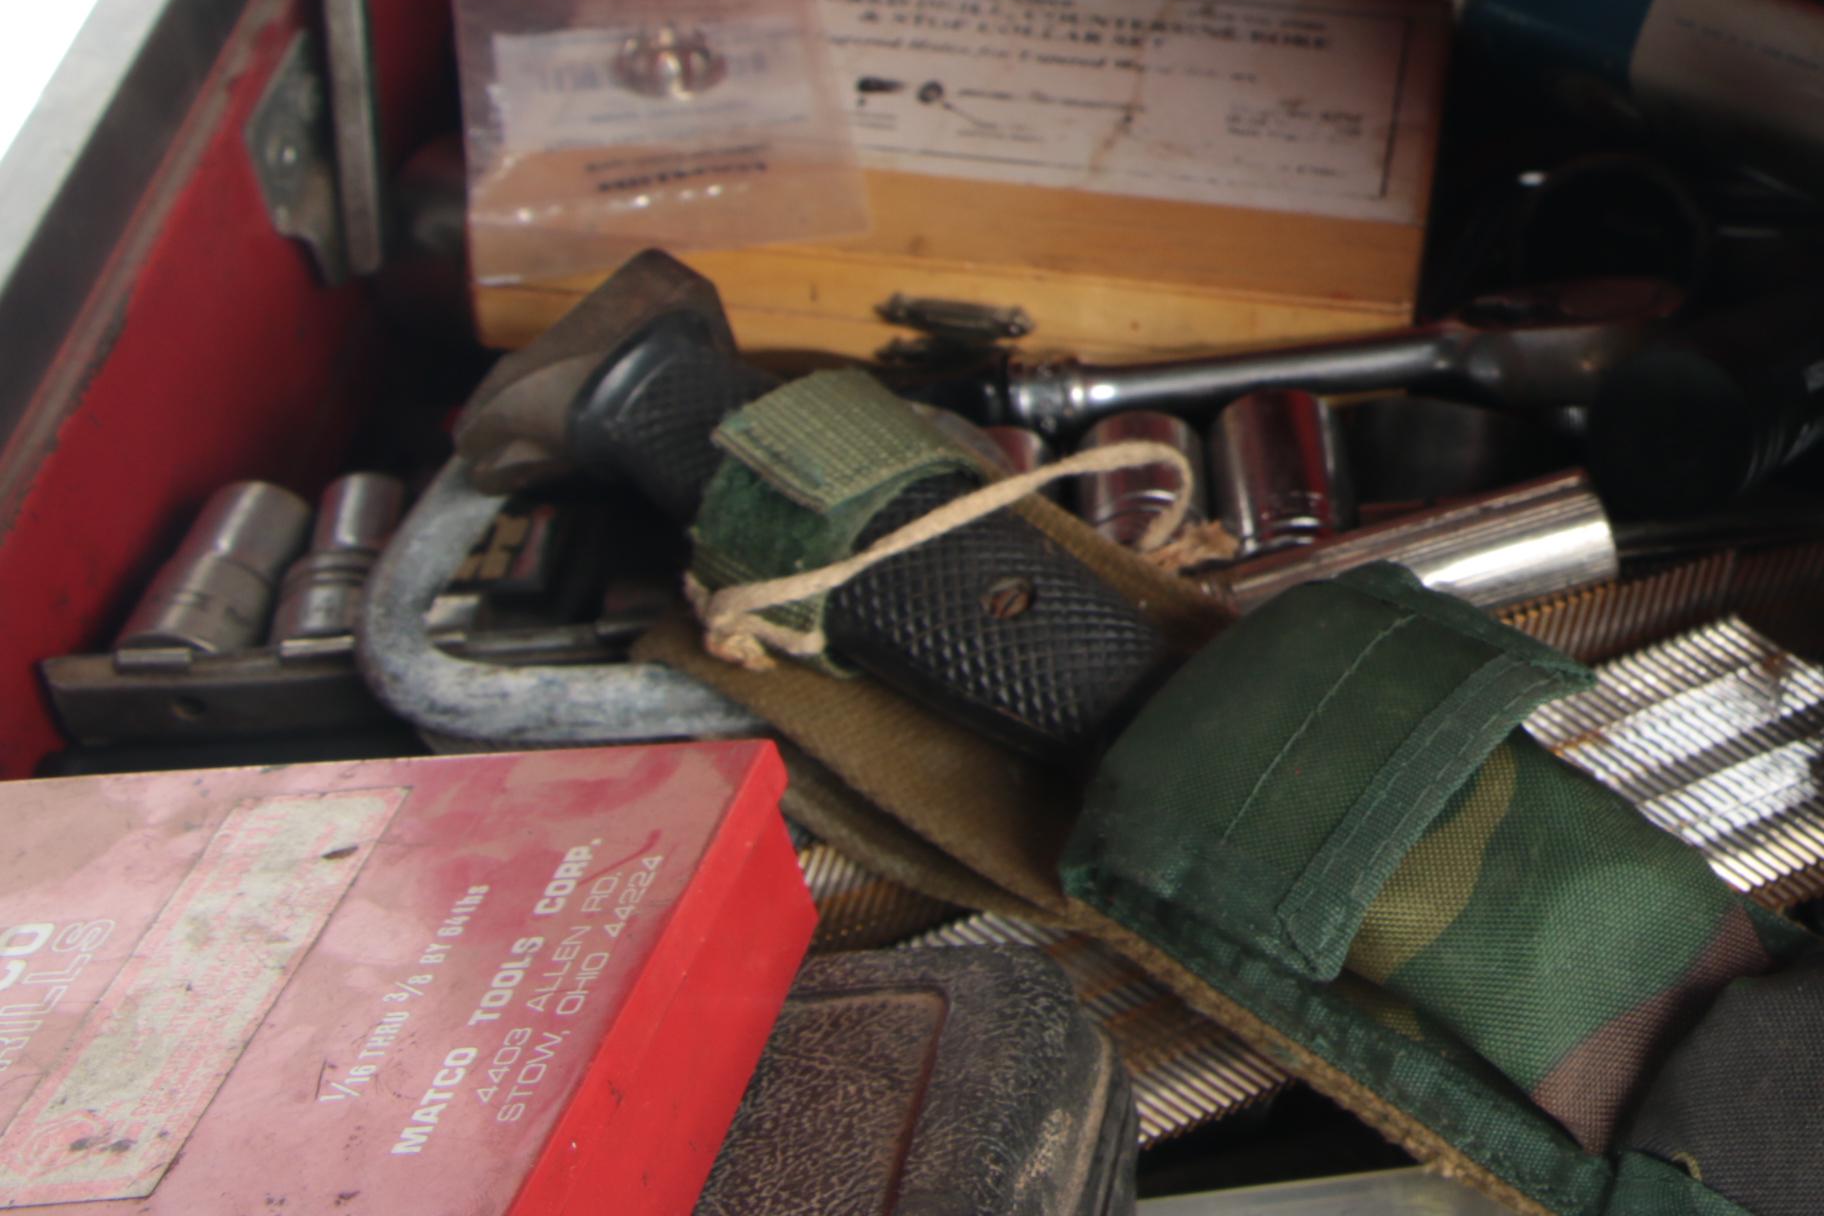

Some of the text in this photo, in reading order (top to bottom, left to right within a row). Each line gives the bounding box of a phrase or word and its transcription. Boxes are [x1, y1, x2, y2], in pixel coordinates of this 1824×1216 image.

[383, 974, 434, 1002] 3/8
[389, 837, 603, 1154] MATCO TOOLS CORP.
[418, 942, 453, 965] BY
[496, 855, 665, 1122] STOW, OHIO 44224
[357, 1010, 411, 1060] THRU
[475, 1027, 533, 1104] 4403
[525, 924, 592, 1013] ALLEN
